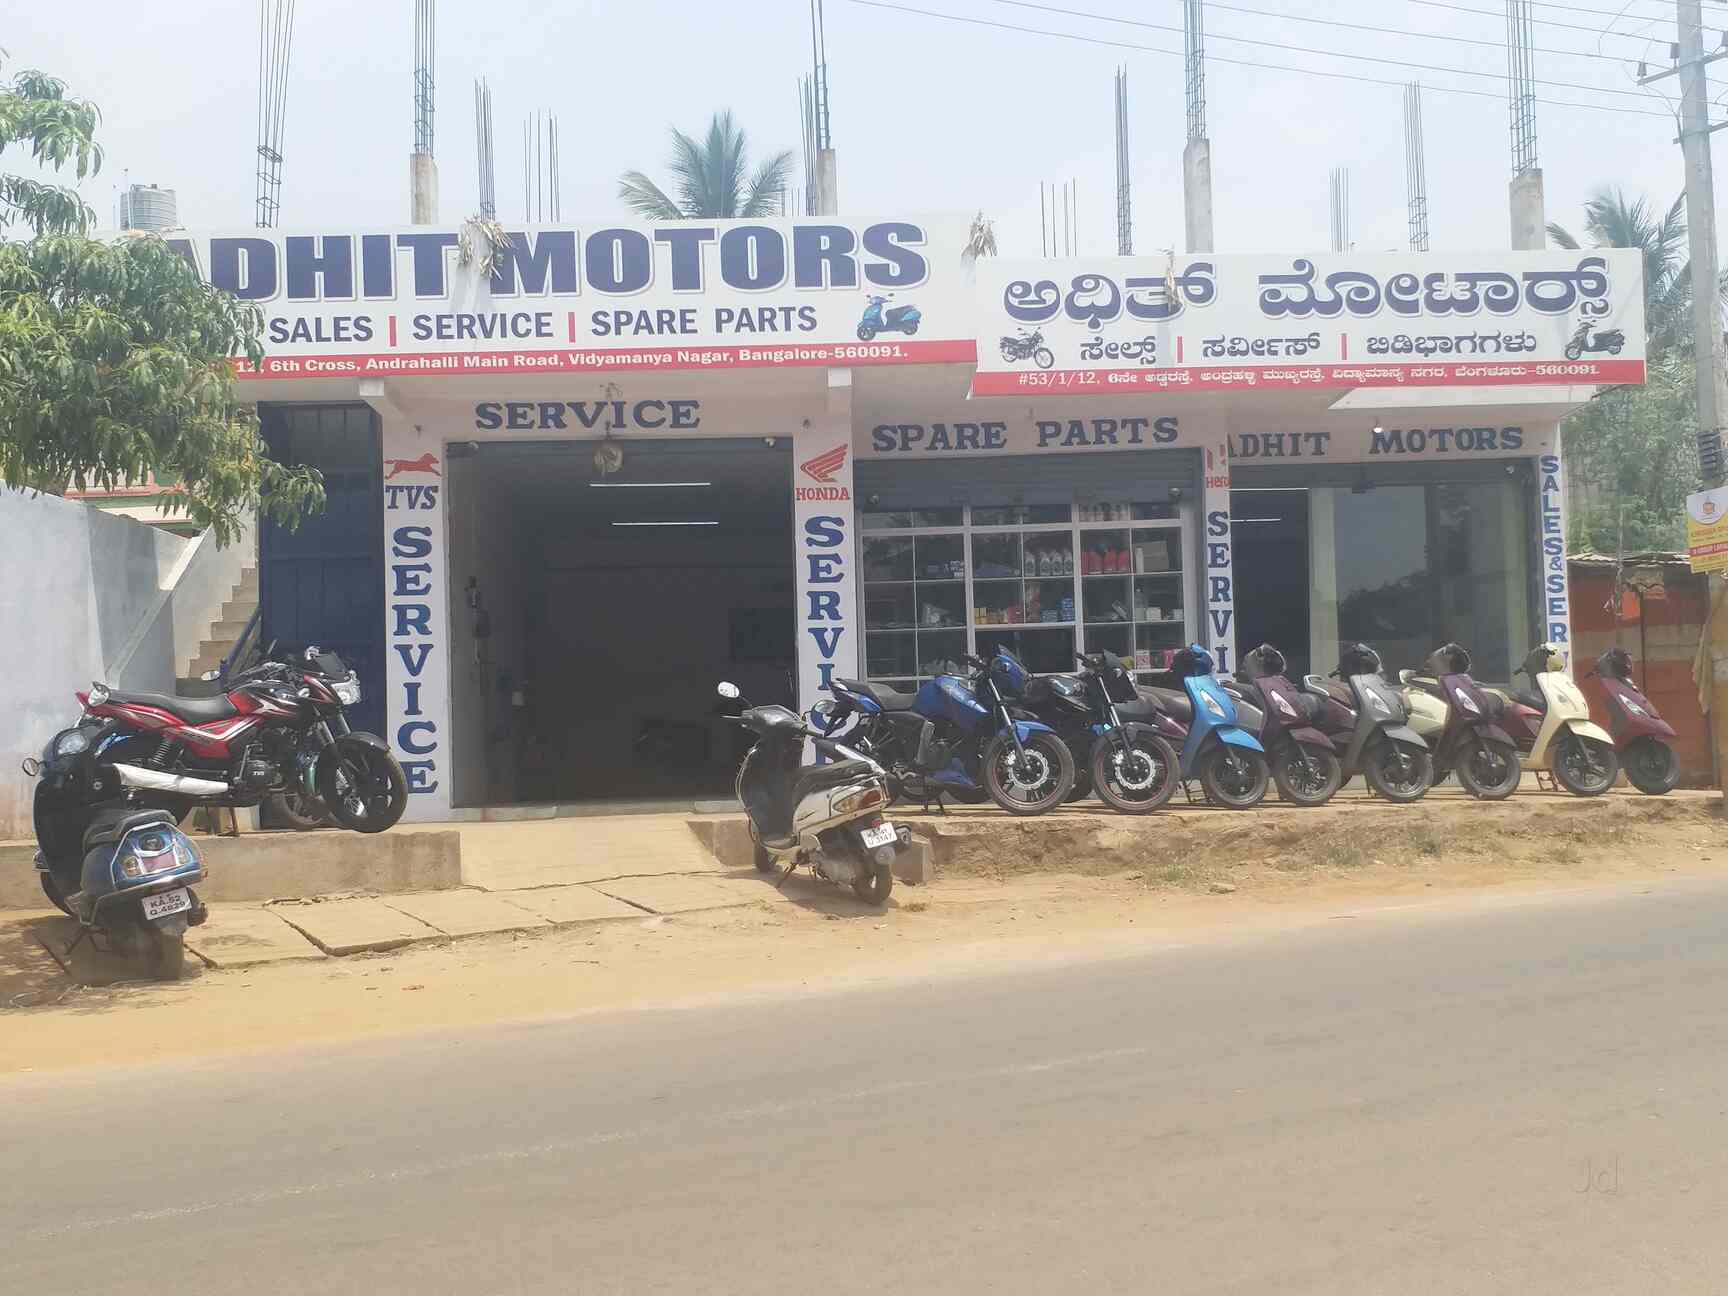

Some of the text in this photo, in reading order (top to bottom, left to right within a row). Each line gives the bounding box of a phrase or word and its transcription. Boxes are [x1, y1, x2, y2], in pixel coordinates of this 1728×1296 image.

[166, 222, 927, 300] DHIT MOTORS
[269, 305, 818, 344] SALES SERVICE SPARE PARTS
[270, 359, 300, 372] 6th
[305, 358, 361, 371] Cross,
[366, 356, 459, 369] Andrahalli
[463, 355, 509, 368] Main
[513, 354, 564, 367] Road,
[568, 351, 673, 367] Vidyamanya
[677, 350, 734, 364] Nagar,
[739, 345, 908, 362] Bangalore-560091.
[1080, 336, 1156, 365] ಸೇಲ್ಸ್
[1366, 330, 1537, 357] ಬಿಡಿಭಾಗಗಳು
[474, 400, 701, 430] SERVICE
[871, 417, 1179, 451] SPARE PARTS
[1368, 427, 1523, 455] MOTORS
[385, 485, 439, 510] TVS
[795, 487, 850, 501] HONDA
[391, 526, 438, 794] SERVICE
